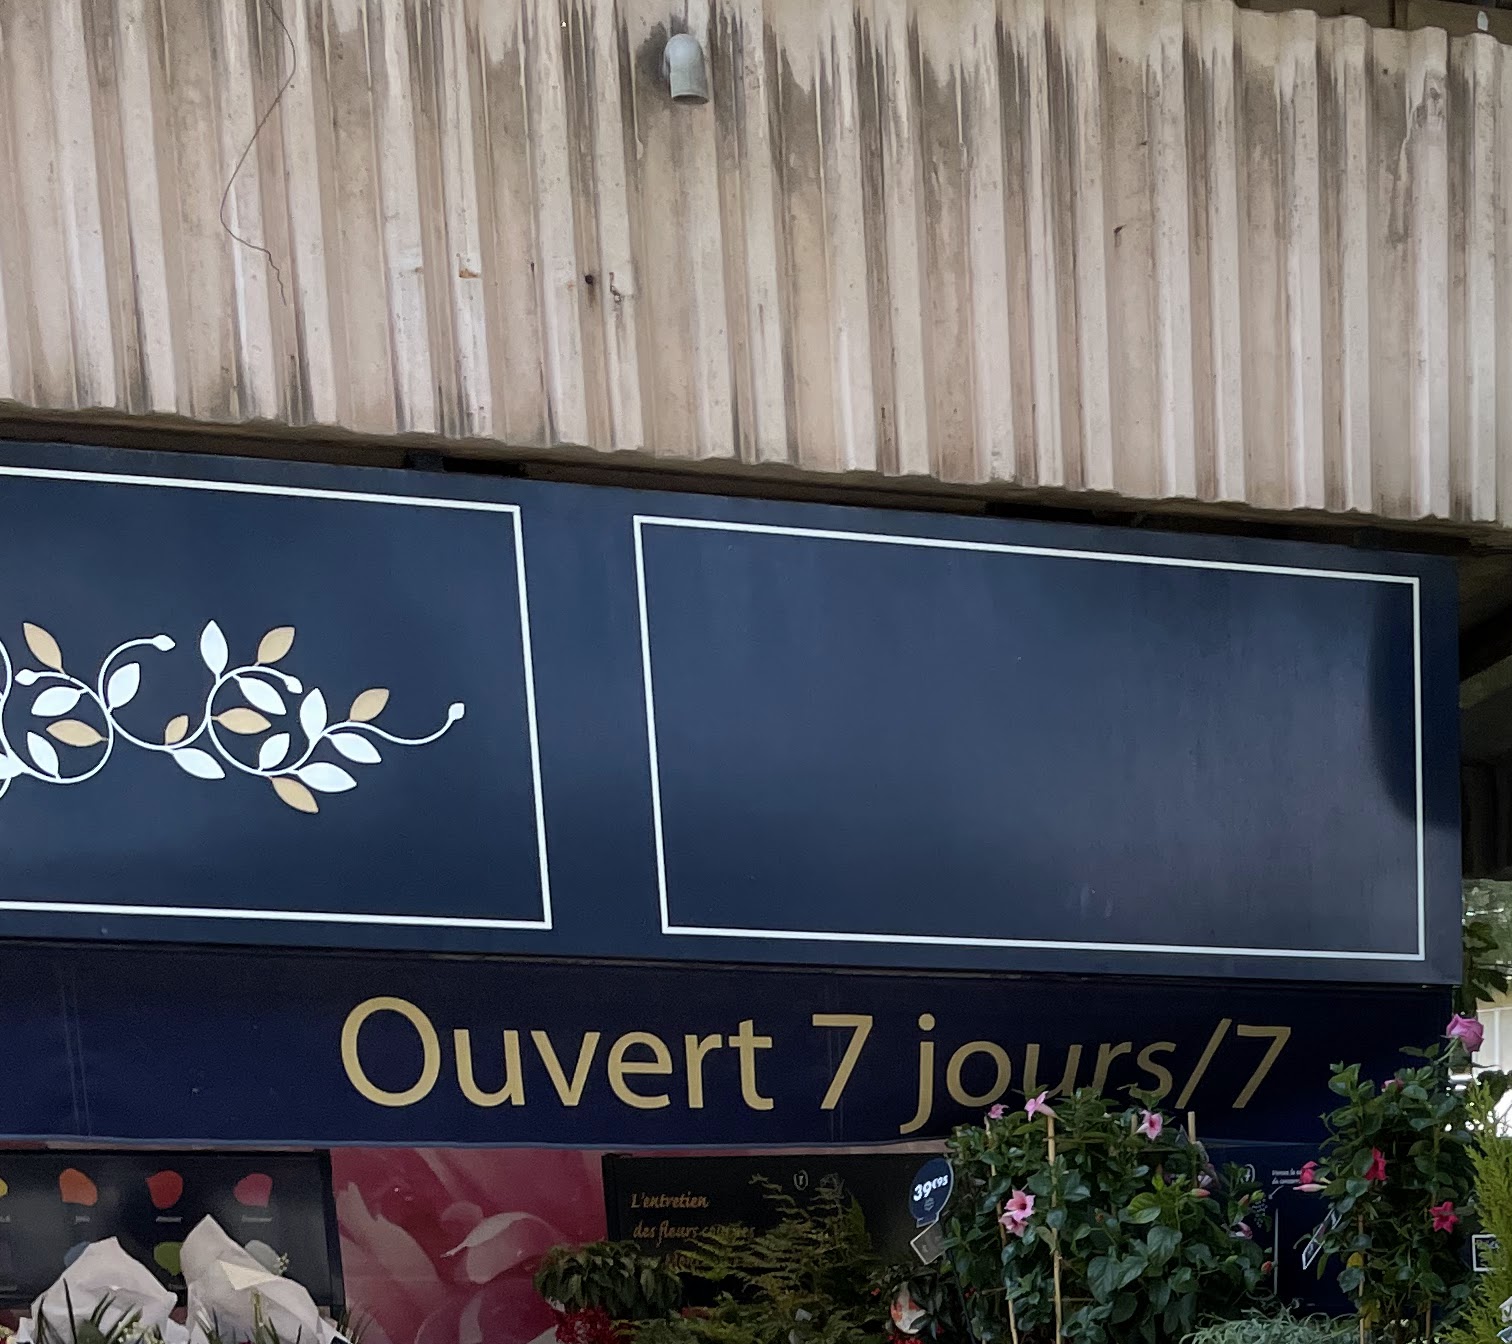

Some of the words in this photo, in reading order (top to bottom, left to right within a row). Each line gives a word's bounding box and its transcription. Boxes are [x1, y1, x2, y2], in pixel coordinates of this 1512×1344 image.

[340, 996, 776, 1111] Ouvert
[811, 1012, 875, 1112] 7
[899, 1012, 1292, 1135] jours/7
[630, 1190, 710, 1209] L'entretien
[913, 1174, 949, 1202] 39€95
[633, 1219, 655, 1239] des
[656, 1220, 699, 1248] fleurs
